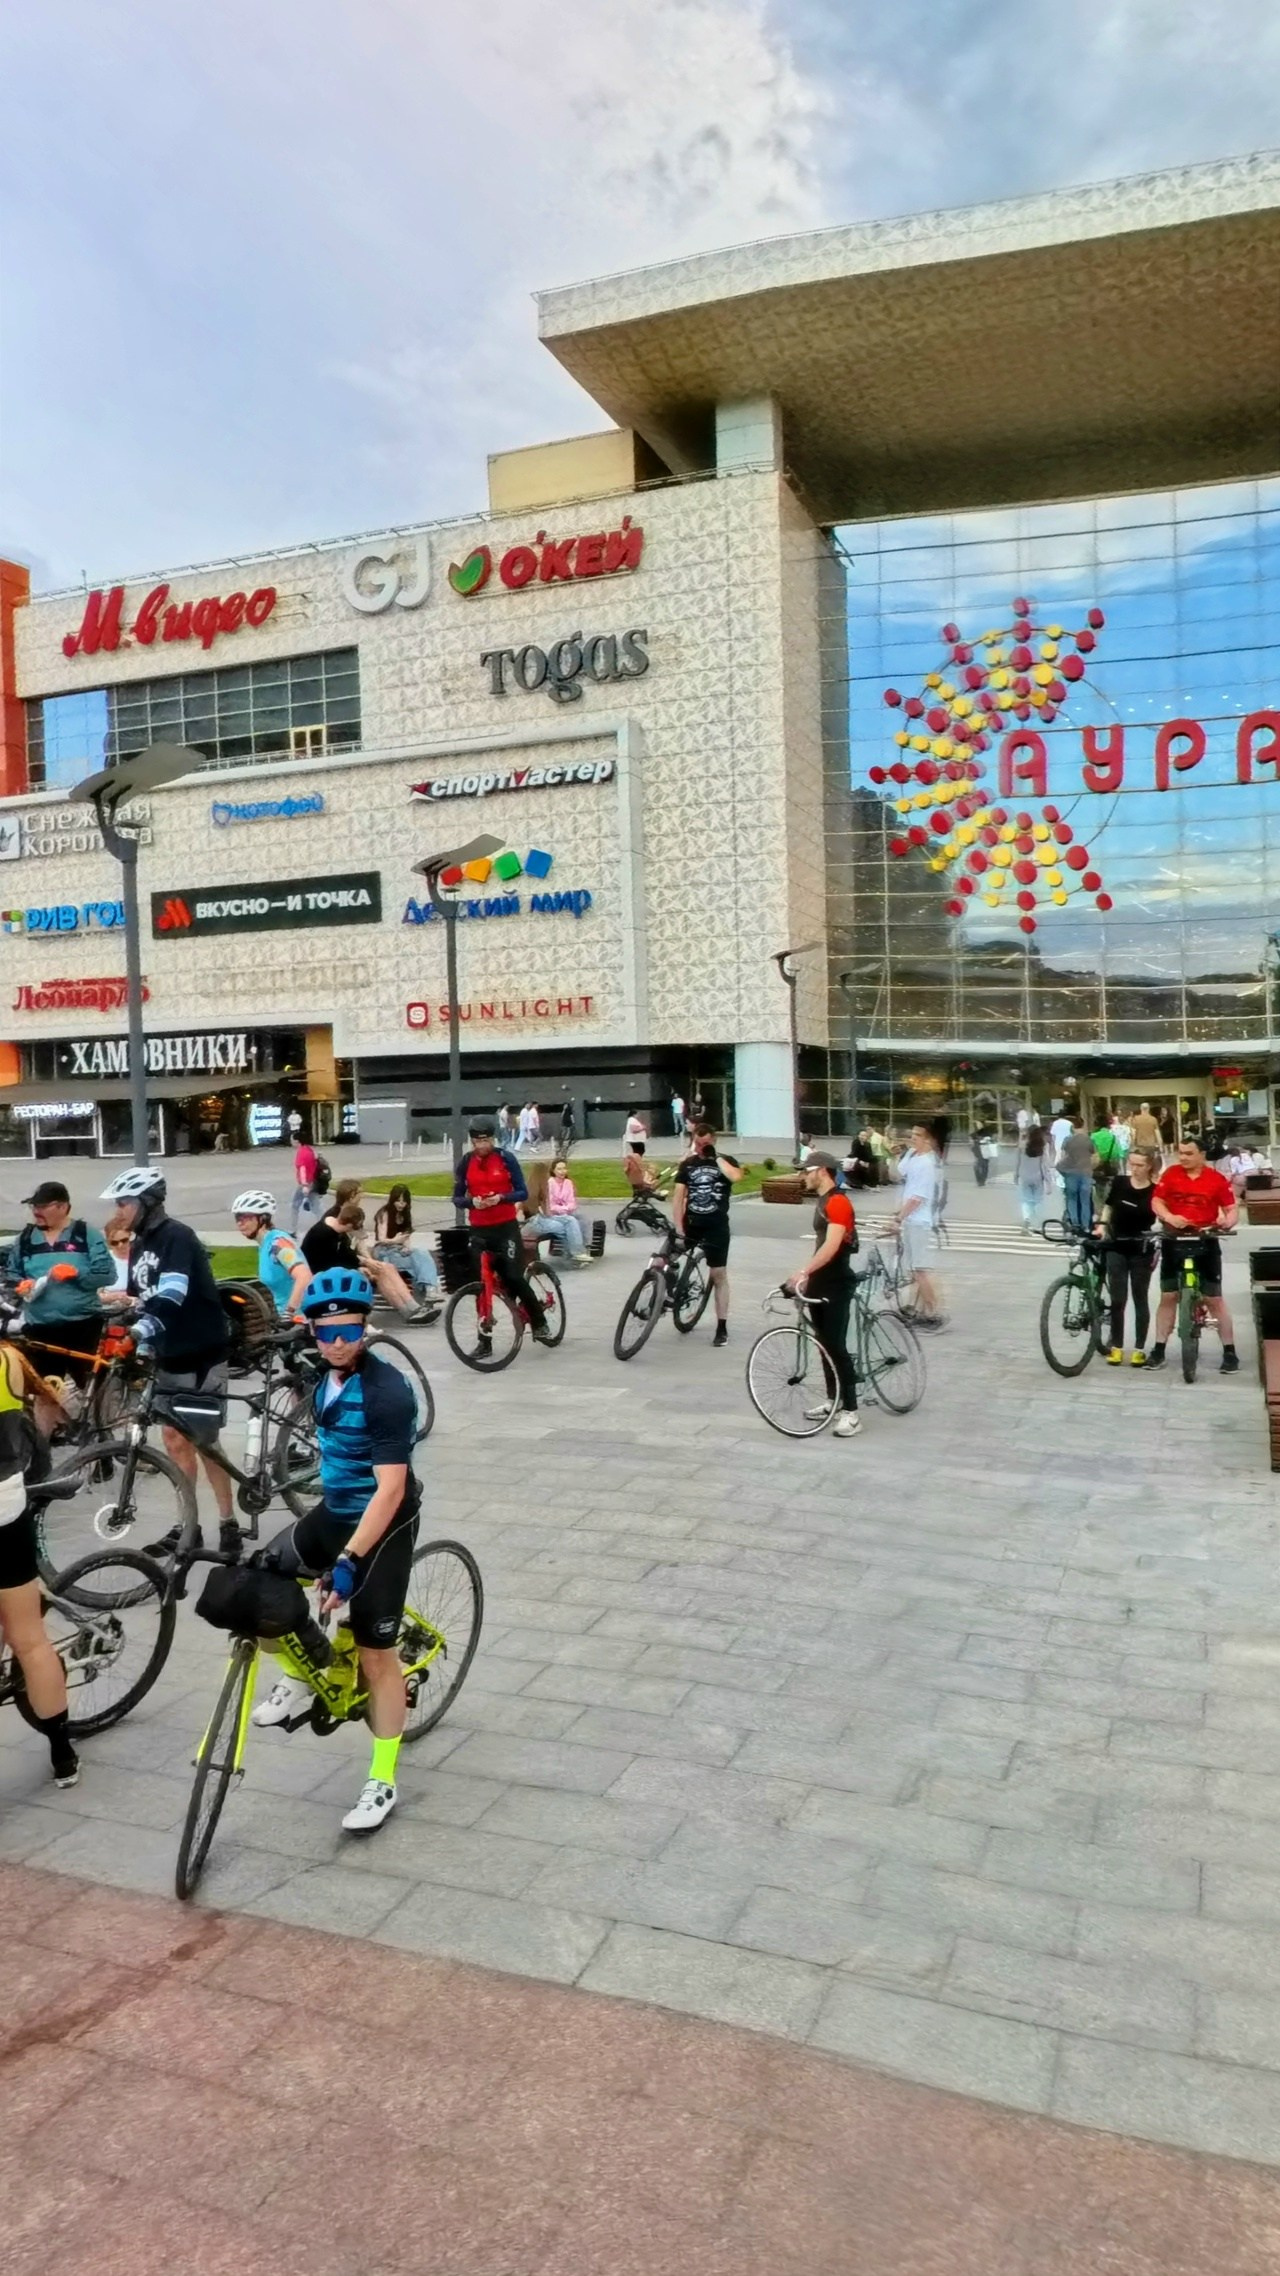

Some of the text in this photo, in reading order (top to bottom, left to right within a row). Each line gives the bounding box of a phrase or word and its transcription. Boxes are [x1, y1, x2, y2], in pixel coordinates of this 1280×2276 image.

[349, 537, 432, 614] GJ
[999, 710, 1280, 797] АУРА
[308, 888, 372, 910] ТОЧКА
[26, 905, 79, 931] РИВ
[439, 996, 594, 1022] SUNLIGHT
[70, 1034, 248, 1074] ХАМВНИКИ
